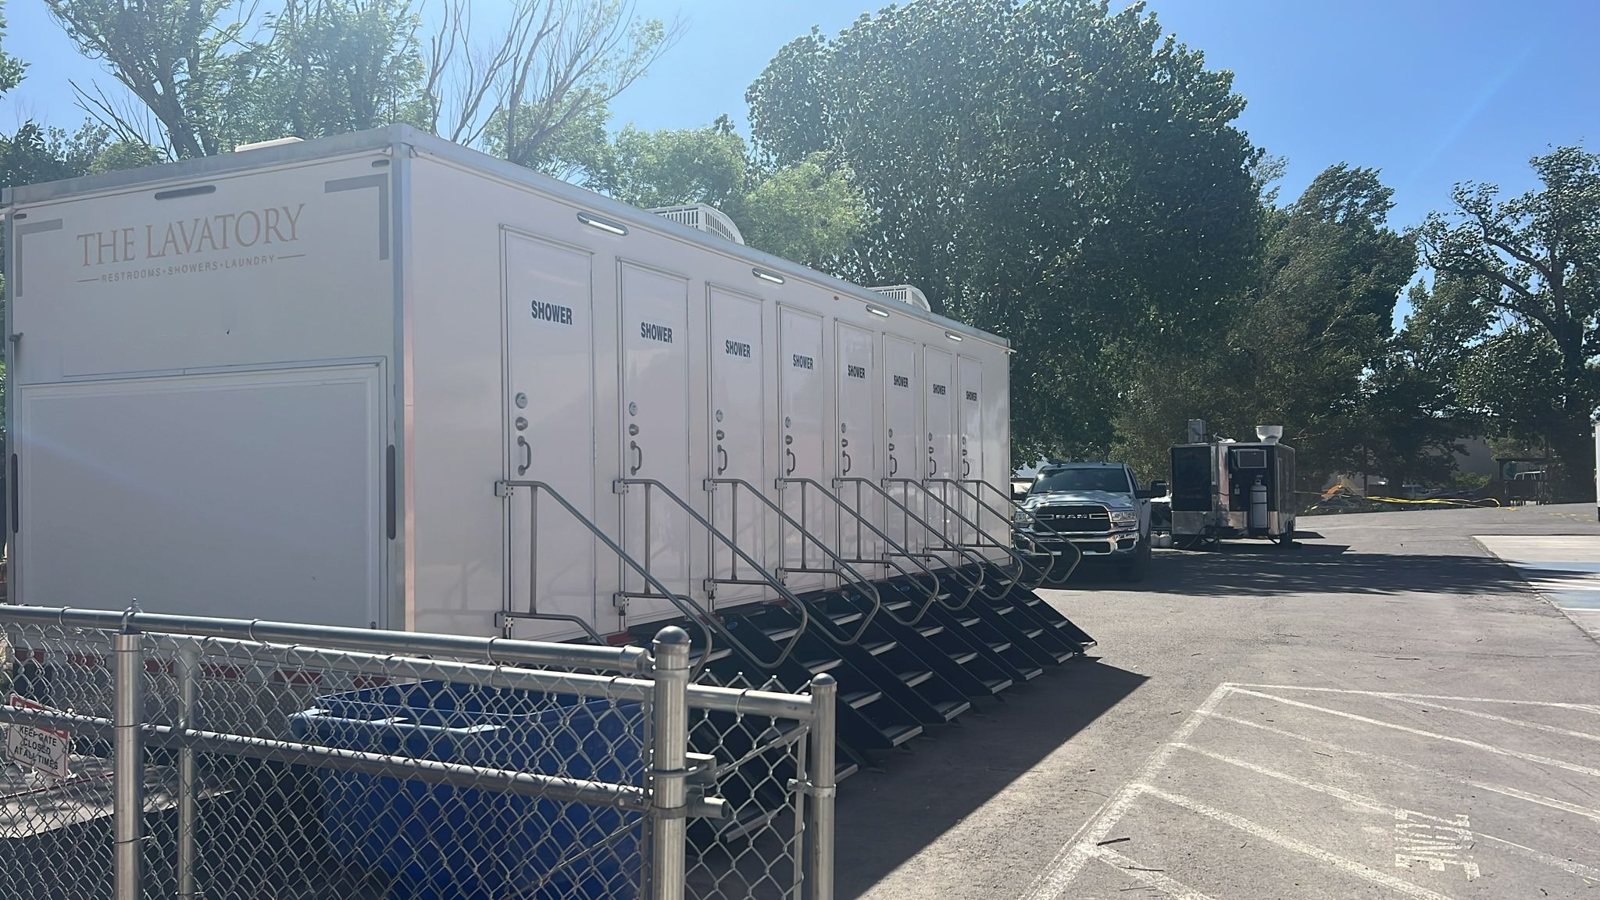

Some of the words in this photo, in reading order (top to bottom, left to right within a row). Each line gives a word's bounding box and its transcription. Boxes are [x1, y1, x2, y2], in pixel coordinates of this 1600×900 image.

[76, 227, 136, 267] THE
[145, 203, 306, 261] LAVATORY
[101, 267, 162, 283] RESTROOMS
[167, 260, 218, 276] SHOWERS
[225, 254, 275, 270] LAUNDRY
[531, 300, 573, 326] SHOWER
[640, 321, 673, 344] SHOWER
[725, 339, 751, 359] SHOWER
[793, 353, 814, 371] SHOWER
[847, 364, 866, 380] SHOWER
[893, 375, 909, 388] SHOWER
[932, 383, 946, 396] SHOWER
[23, 738, 51, 755] CLOSED
[38, 733, 57, 747] GATE
[14, 746, 23, 755] AT
[38, 754, 58, 770] TIMES
